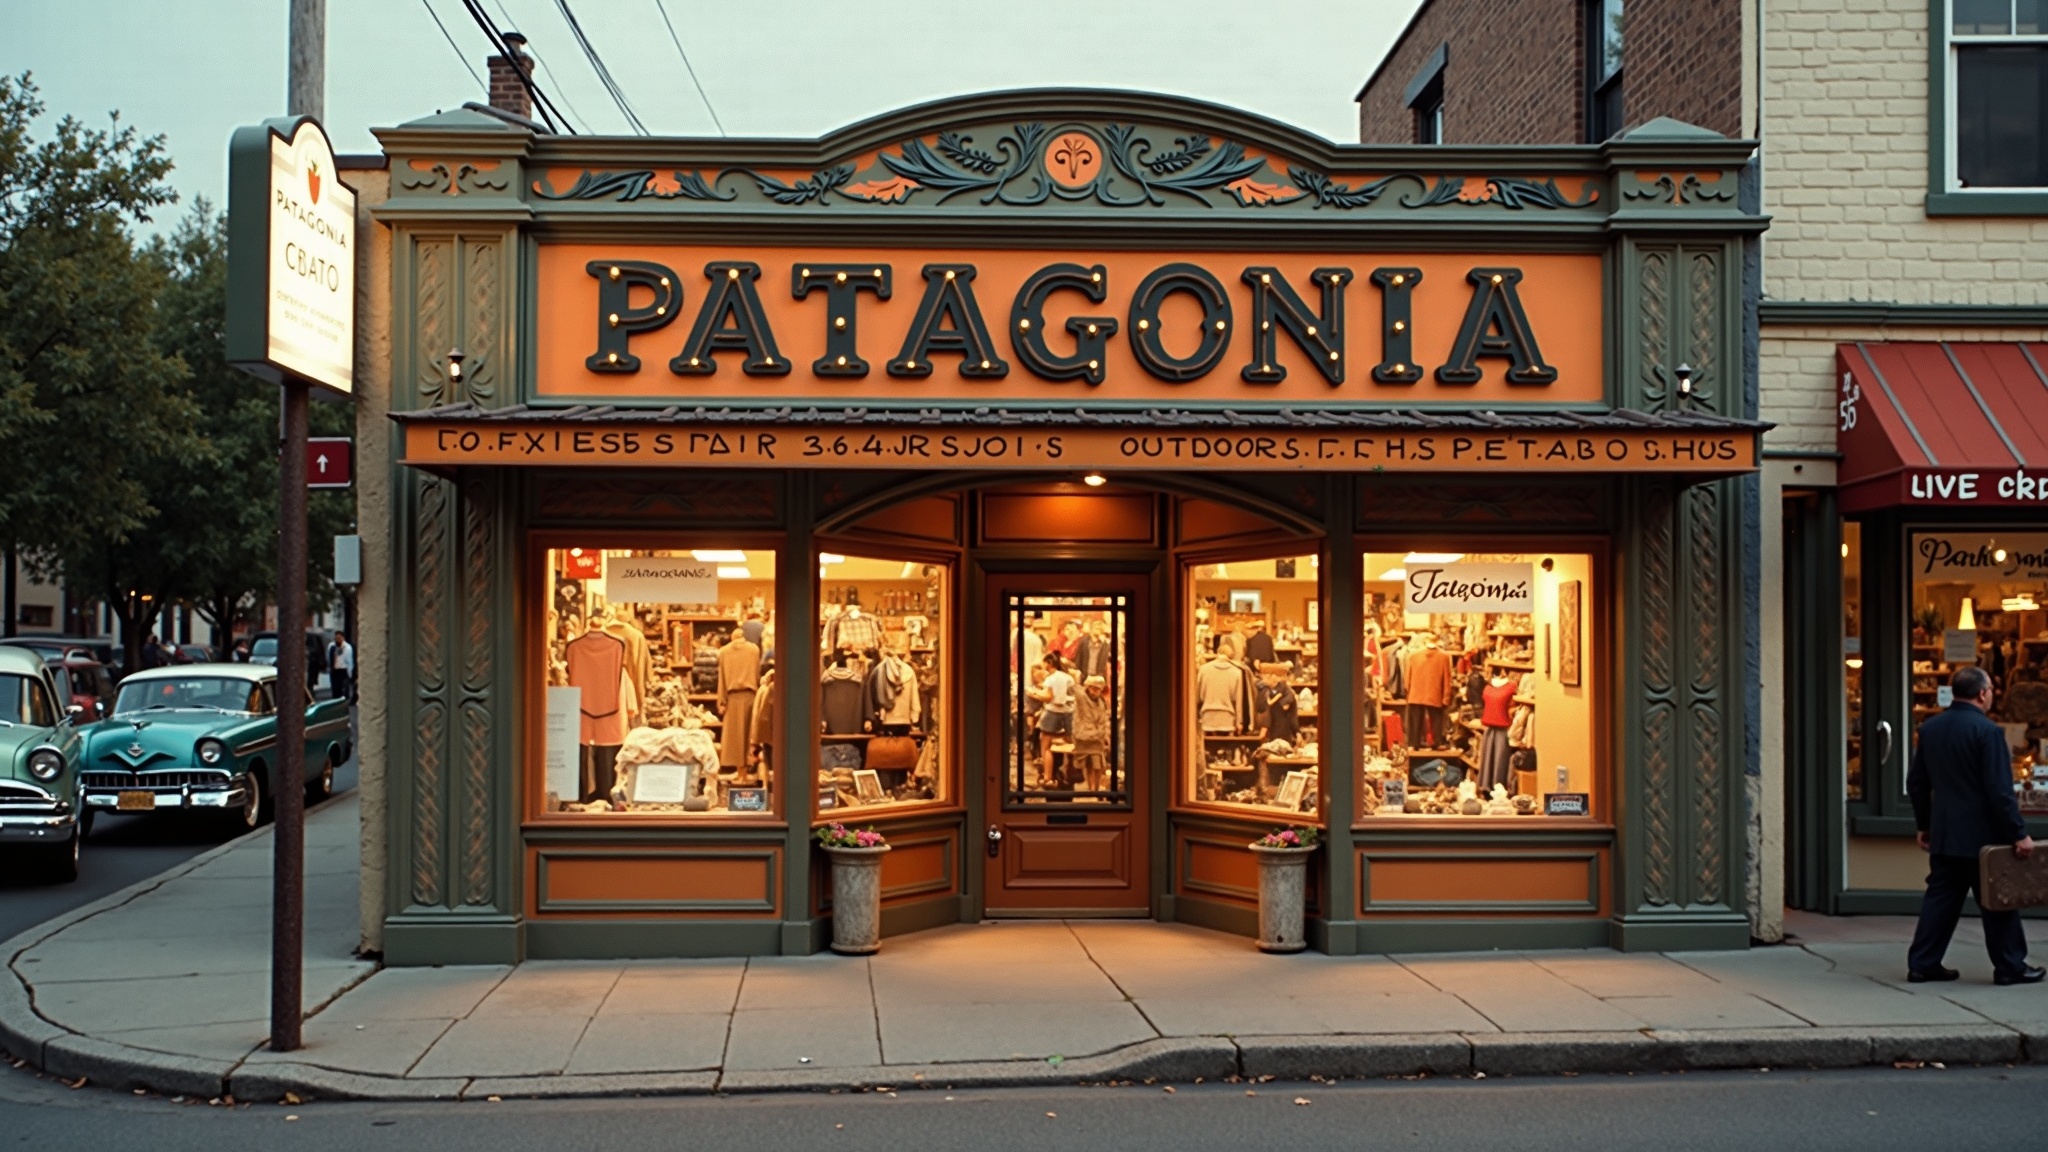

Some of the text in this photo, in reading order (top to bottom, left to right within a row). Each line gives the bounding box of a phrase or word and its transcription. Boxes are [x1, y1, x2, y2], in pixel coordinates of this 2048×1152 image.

[277, 189, 347, 249] PATAGONIA
[585, 261, 1558, 384] PATAGONIA
[1911, 473, 1980, 499] LIVE
